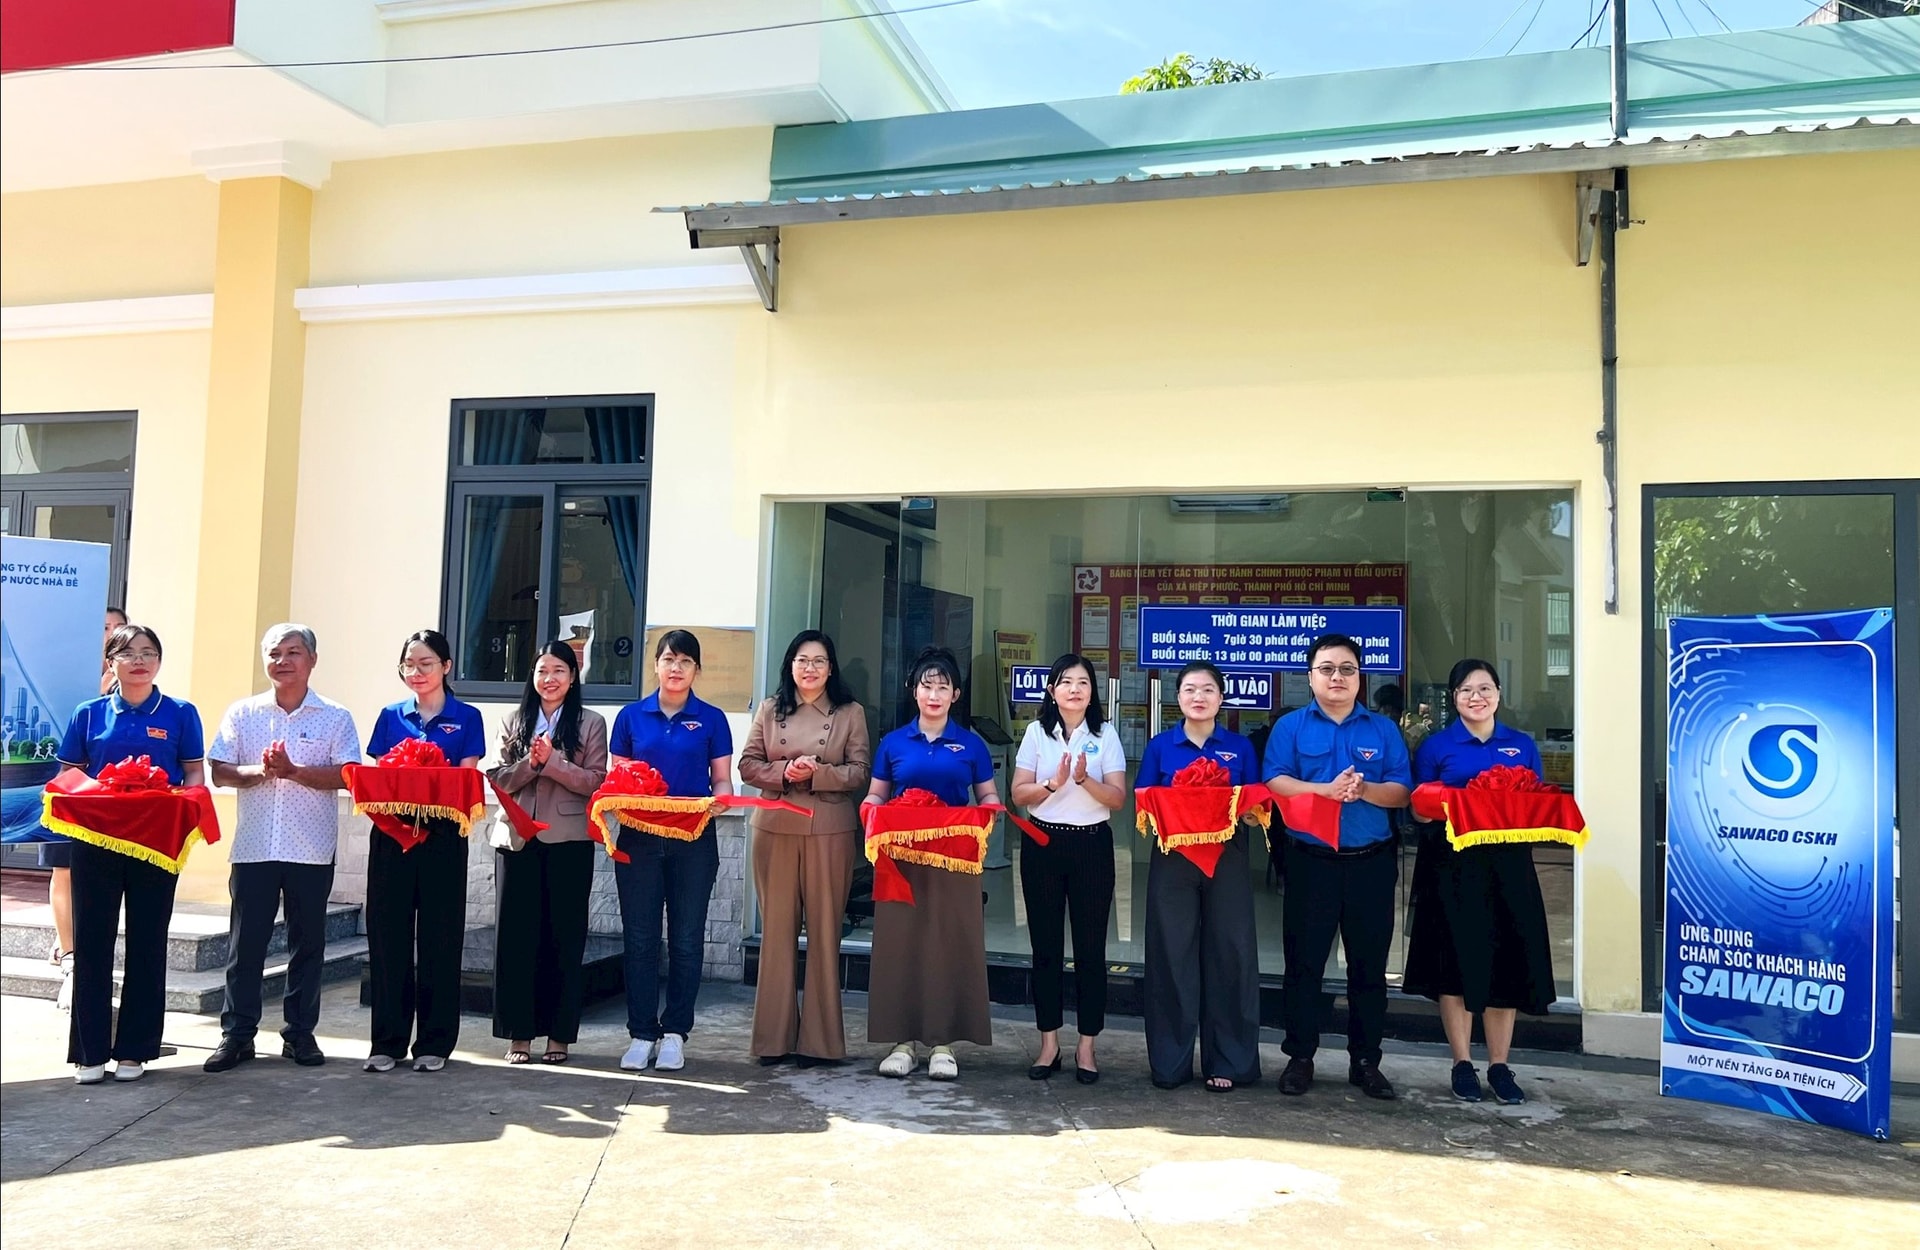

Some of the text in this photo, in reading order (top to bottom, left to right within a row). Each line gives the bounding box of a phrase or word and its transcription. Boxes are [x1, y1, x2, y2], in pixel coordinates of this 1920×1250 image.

[1, 563, 15, 572] NG
[17, 564, 31, 573] TY
[1174, 566, 1191, 578] CÁC
[1229, 566, 1253, 578] HÀNH
[9, 575, 40, 585] NƯỚC
[42, 576, 63, 587] NHÀ
[1325, 582, 1350, 592] MINH
[1211, 612, 1327, 630] THỜI GIAN LÀM VIỆC
[618, 639, 630, 654] 2
[1178, 631, 1210, 644] SÁNG:
[1223, 634, 1247, 646] 7giờ
[1248, 634, 1262, 645] 30
[1264, 634, 1288, 647] phút
[1290, 633, 1310, 646] đến
[1365, 636, 1390, 648] phút
[1215, 650, 1227, 660] 13
[1229, 650, 1247, 662] giờ
[1248, 651, 1262, 662] 00
[1264, 651, 1288, 663] phút
[1365, 653, 1390, 665] phút
[1015, 669, 1037, 689] LỐI
[1222, 674, 1268, 696] ỐI VÀO
[1717, 825, 1838, 846] SAWACO CSKH
[1680, 922, 1753, 949] ỨNG DỤNG
[1679, 944, 1846, 982] CHĂM SÓC KHÁCH HÀNG
[1679, 964, 1845, 1016] SAWACO
[1687, 1054, 1714, 1069] MỘT
[1741, 1061, 1773, 1077] TẢNG
[1775, 1069, 1791, 1081] ĐA
[1793, 1072, 1816, 1087] TIỆN
[1817, 1075, 1836, 1090] ÍCH
